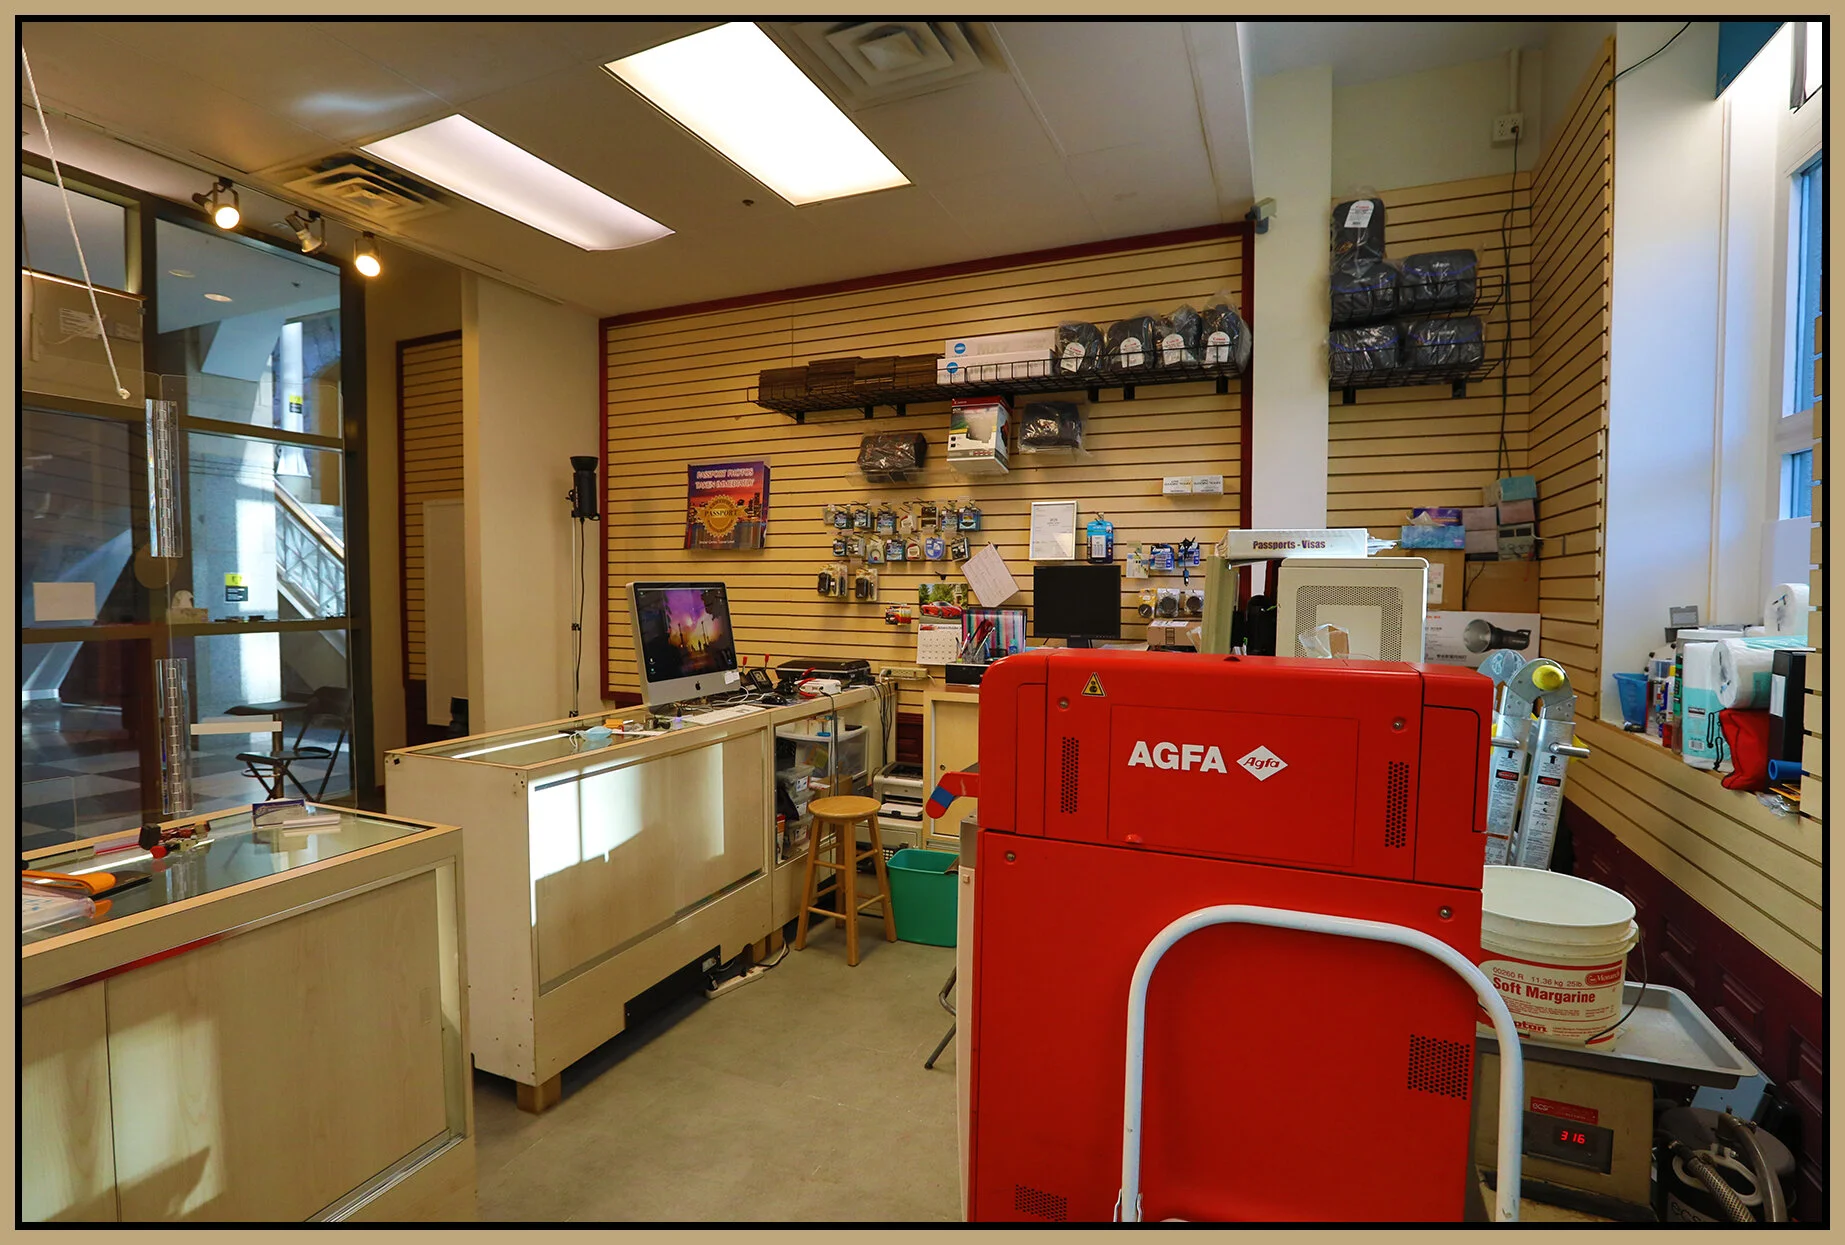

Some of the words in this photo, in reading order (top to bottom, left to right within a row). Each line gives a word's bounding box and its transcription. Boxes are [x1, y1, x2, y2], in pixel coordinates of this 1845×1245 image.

[704, 509, 738, 517] PASSPORT
[1252, 540, 1296, 550] Passports
[1301, 540, 1326, 549] Visas
[1127, 740, 1228, 774] AGFA
[1243, 756, 1281, 770] Agfa
[1492, 966, 1516, 978] 00260
[1517, 972, 1524, 980] R
[1531, 976, 1553, 986] 11.36
[1554, 980, 1564, 988] kg
[1492, 976, 1522, 995] Soft
[1525, 986, 1596, 1005] Margarine
